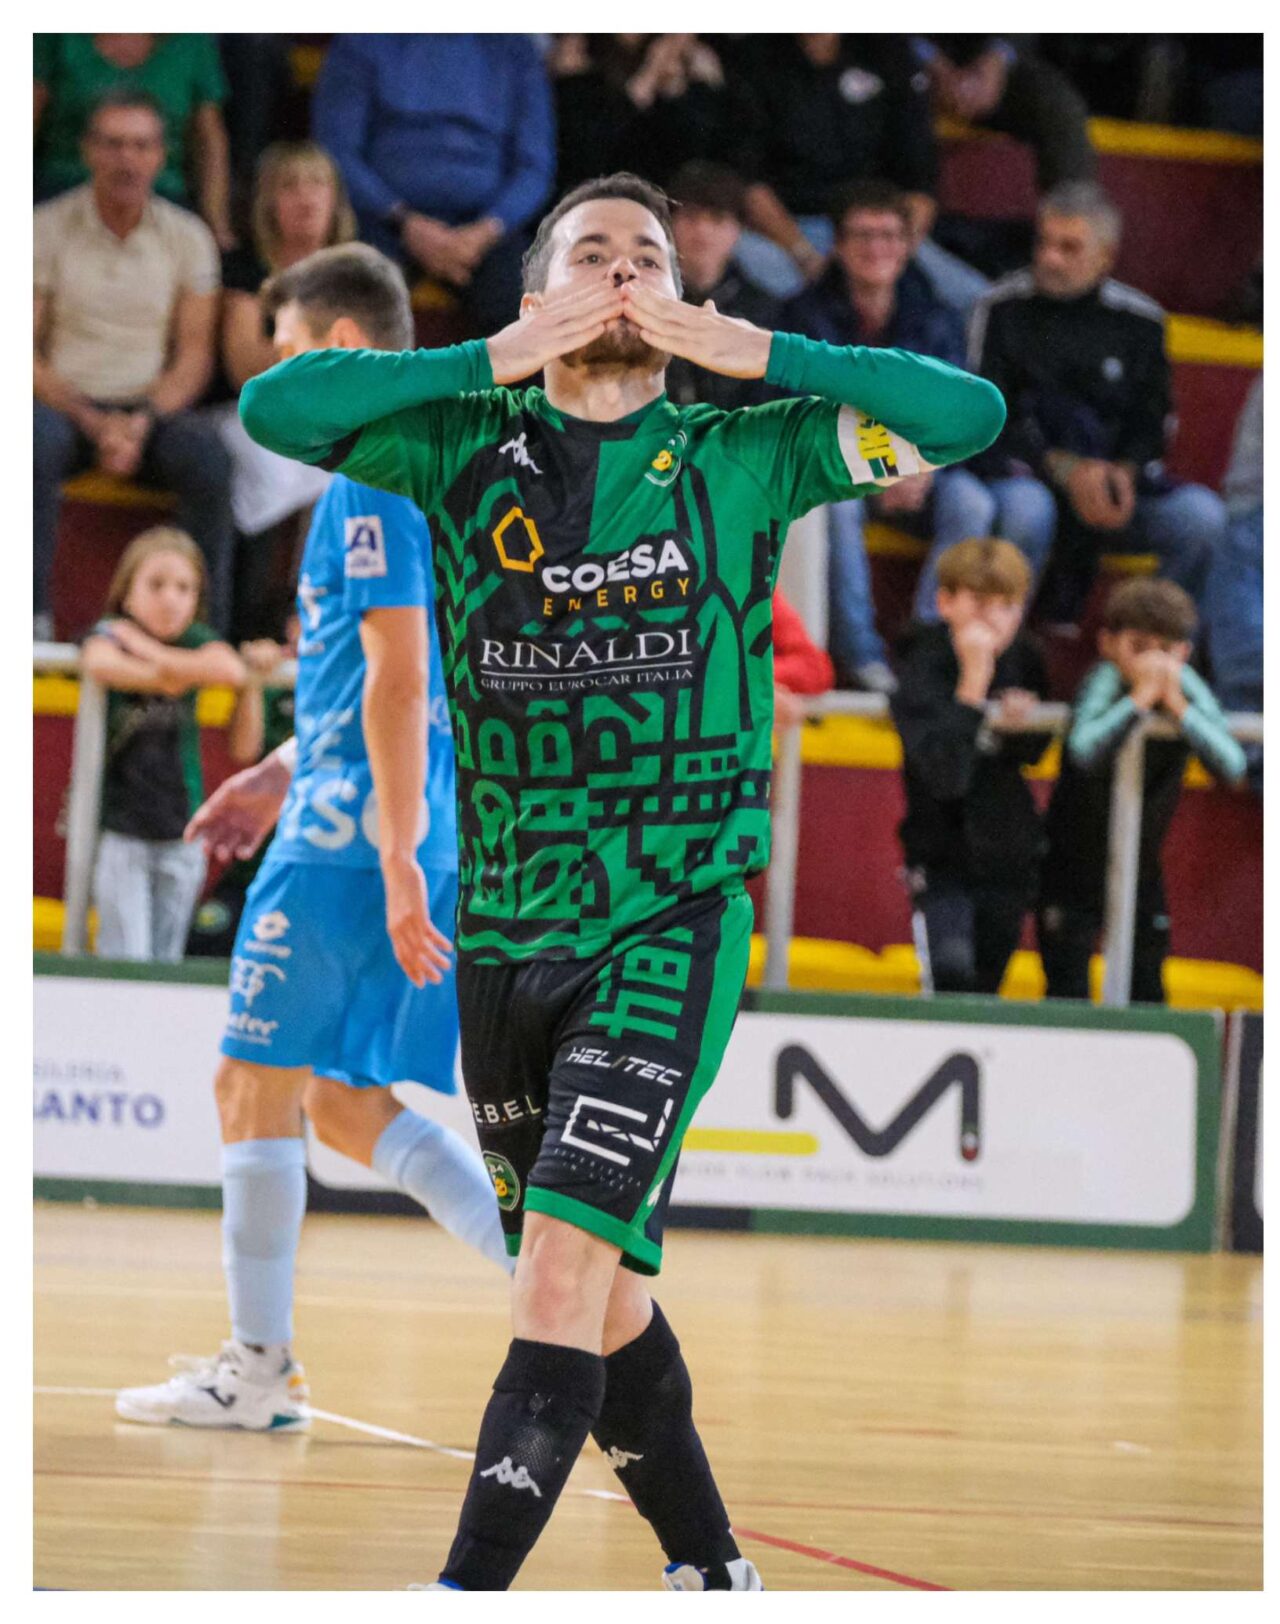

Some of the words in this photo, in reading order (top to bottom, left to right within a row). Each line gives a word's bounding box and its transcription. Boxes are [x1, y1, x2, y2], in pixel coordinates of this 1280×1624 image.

[541, 539, 689, 593] COESA
[543, 577, 690, 616] ENERGY
[480, 628, 694, 669] RINALDI
[480, 676, 543, 692] GRUPPO
[549, 672, 631, 692] EUROCAR
[636, 668, 694, 684] ITALIA
[566, 1046, 683, 1086] HELITEC
[33, 1089, 166, 1129] ANTO
